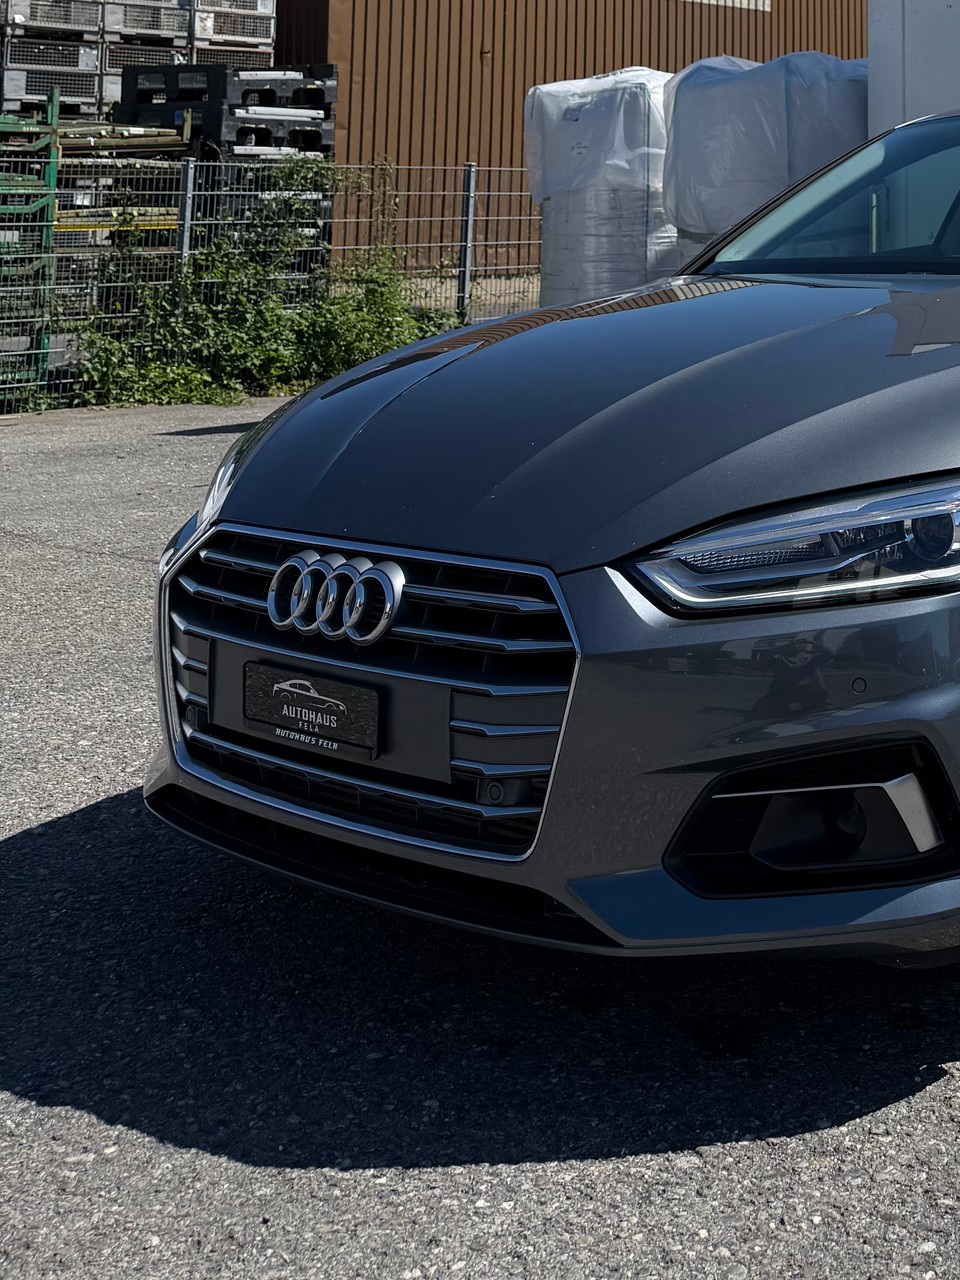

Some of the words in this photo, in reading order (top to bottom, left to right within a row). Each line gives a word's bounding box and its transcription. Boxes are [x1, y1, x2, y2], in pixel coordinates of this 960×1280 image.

[282, 704, 337, 728] AUTOHAUS
[299, 721, 319, 733] FELA
[275, 728, 316, 745] AUTOHAUS
[318, 739, 338, 750] FELA
